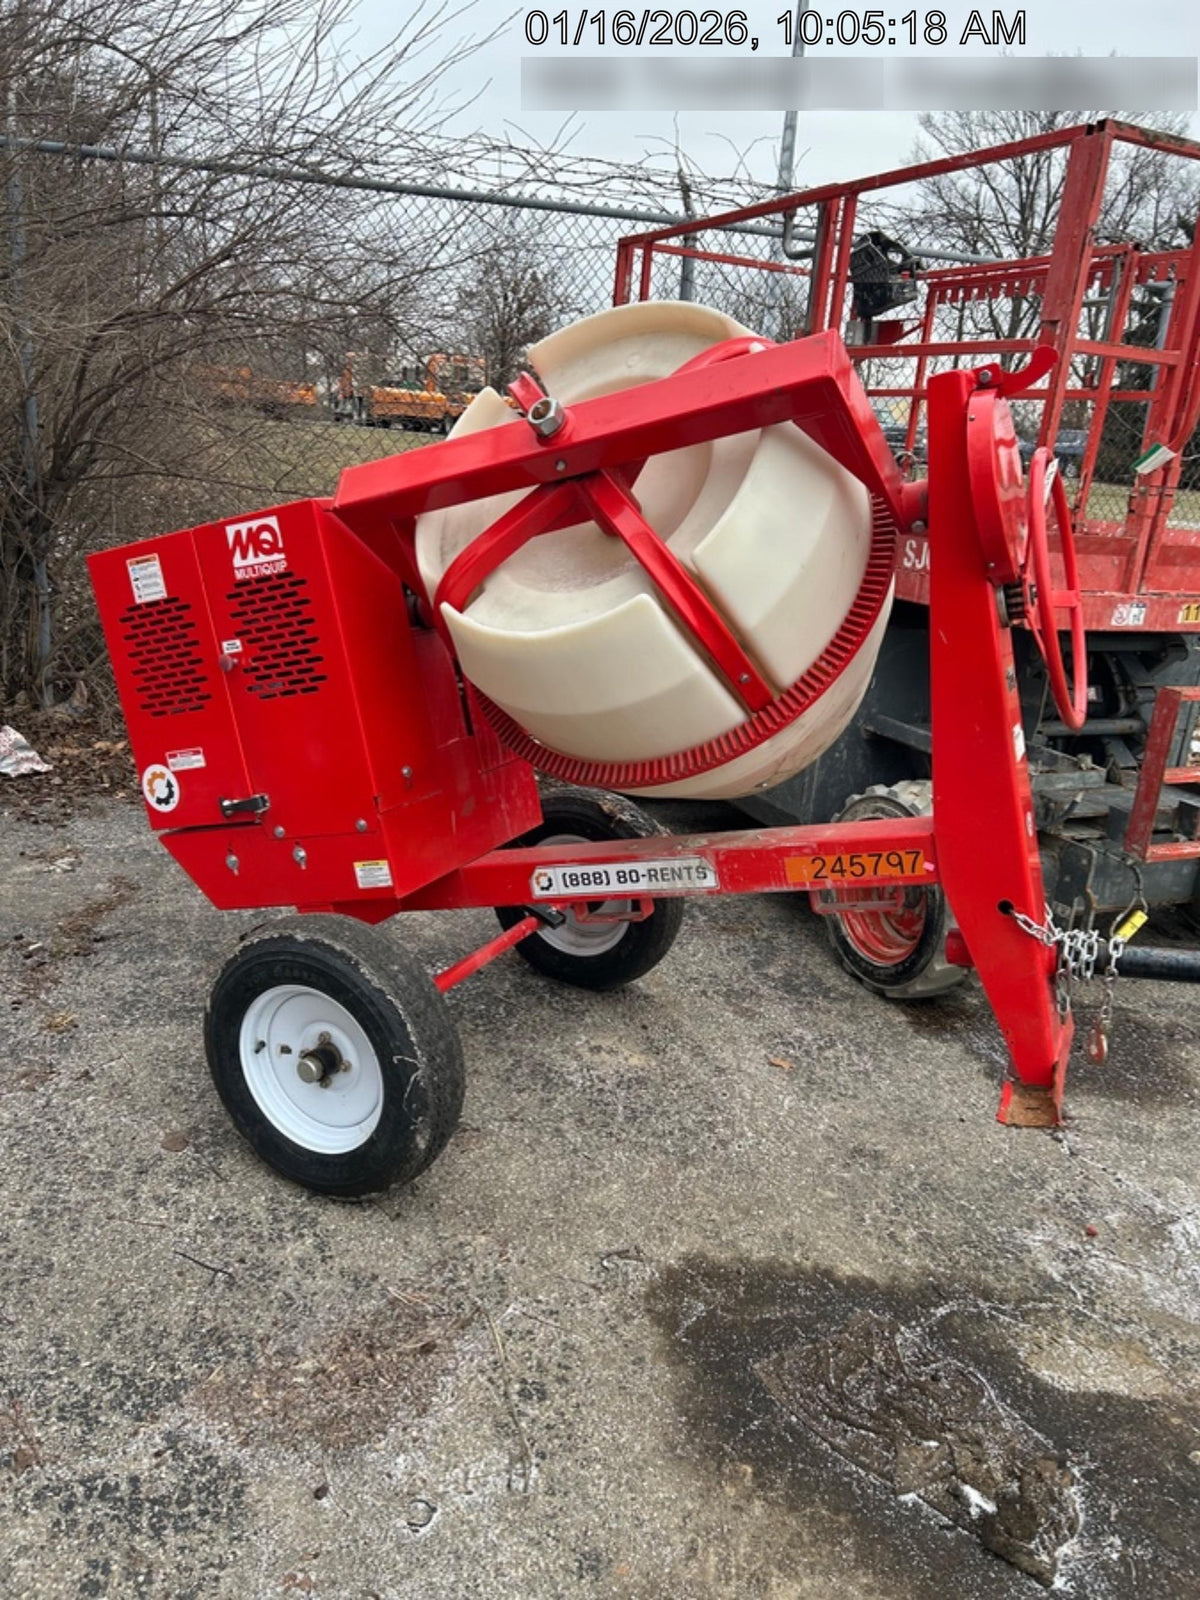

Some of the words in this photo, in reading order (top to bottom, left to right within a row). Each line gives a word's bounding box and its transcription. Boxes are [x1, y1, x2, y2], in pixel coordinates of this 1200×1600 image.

[227, 519, 285, 563] MQ
[234, 560, 288, 580] MULTIQUIP
[562, 870, 610, 888] (888)
[616, 865, 708, 884] 80-RENTS
[811, 850, 921, 879] 245797
